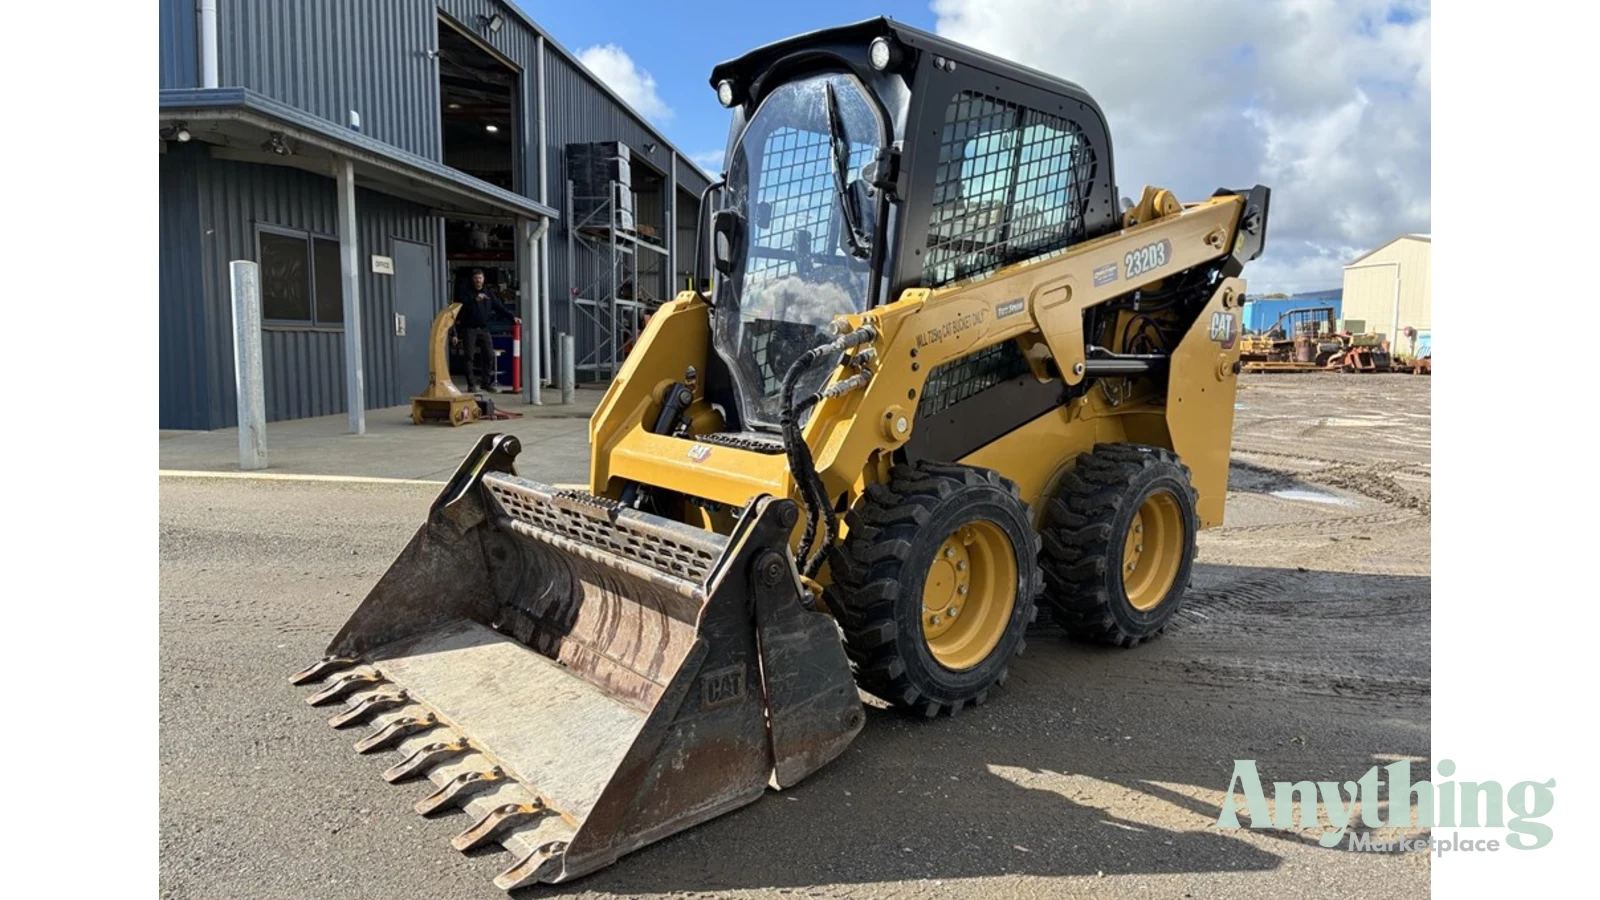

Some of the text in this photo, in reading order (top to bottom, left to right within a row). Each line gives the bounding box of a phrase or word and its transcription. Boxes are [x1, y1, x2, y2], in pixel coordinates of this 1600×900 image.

[1125, 241, 1165, 279] 232D3
[942, 322, 953, 338] CAT
[953, 314, 972, 334] BUCKET
[1211, 312, 1233, 341] CAT
[687, 445, 710, 460] CAT
[708, 672, 741, 703] CAT
